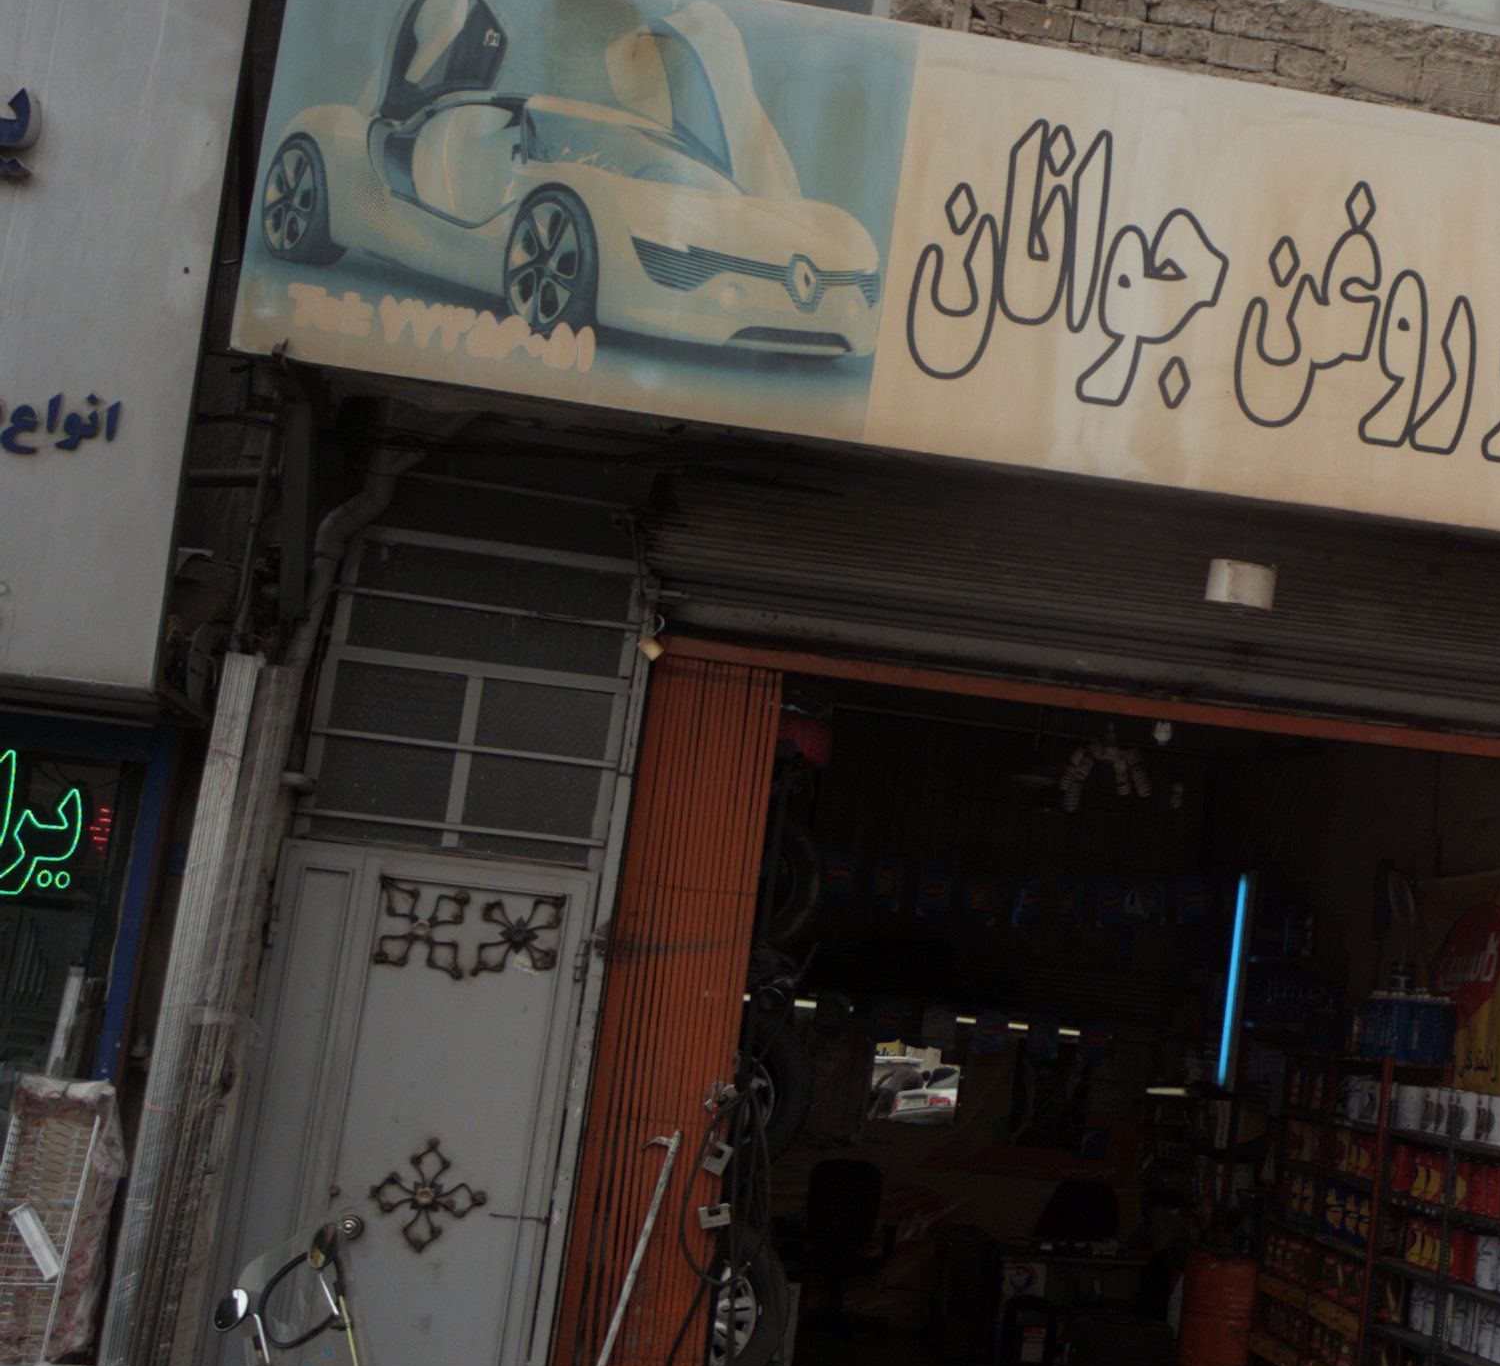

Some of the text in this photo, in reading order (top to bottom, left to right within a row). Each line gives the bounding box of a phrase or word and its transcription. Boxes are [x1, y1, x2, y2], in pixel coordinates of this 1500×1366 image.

[904, 119, 1229, 411] جوانان
[1234, 179, 1477, 456] روغن
[1, 392, 122, 454] انواع
